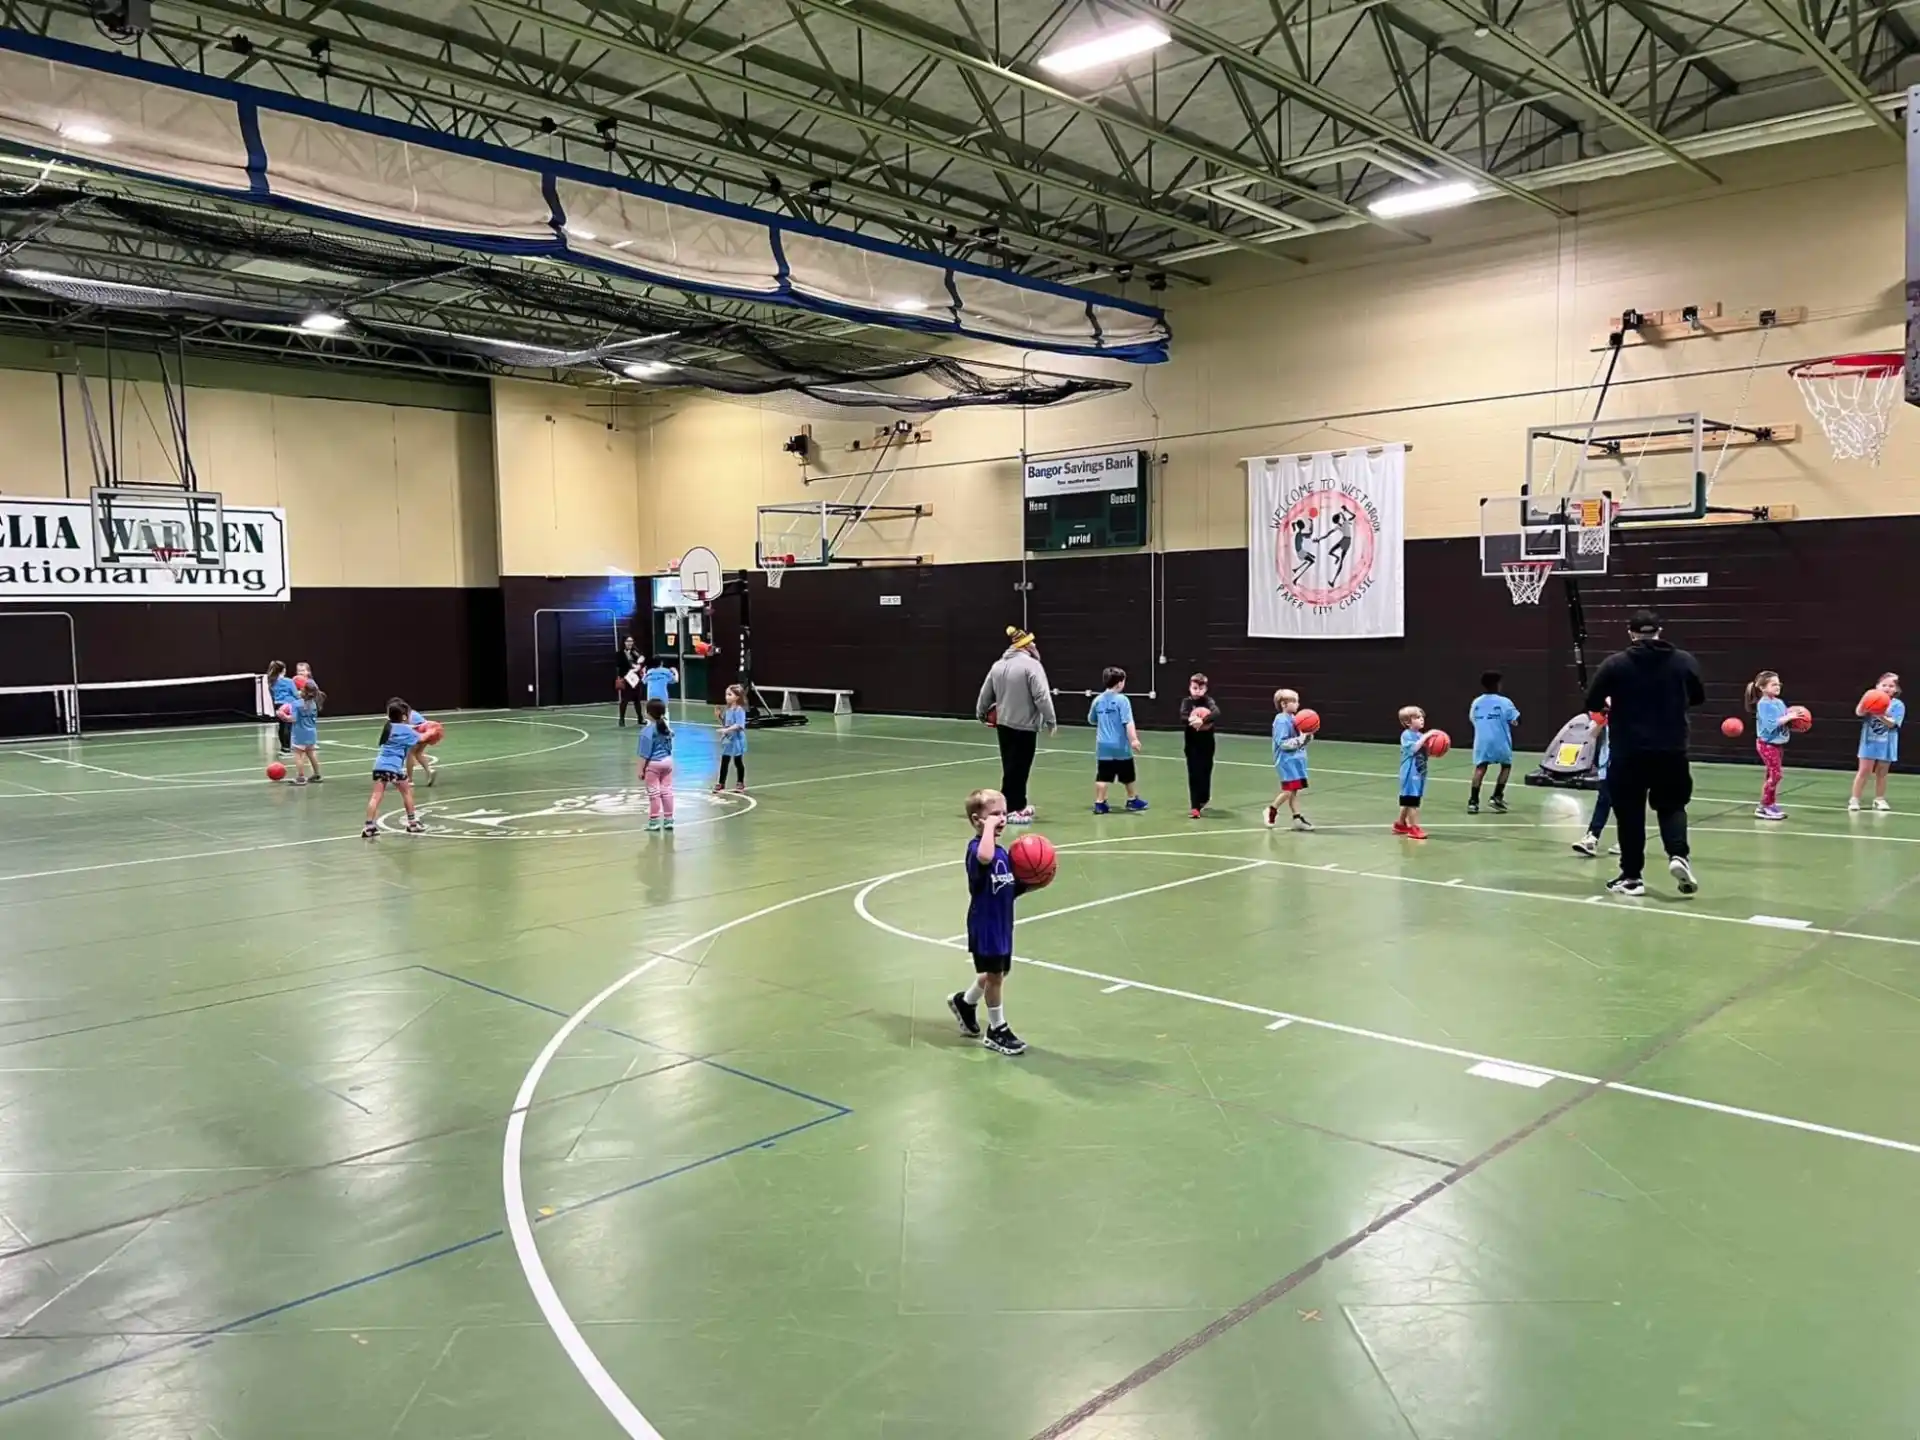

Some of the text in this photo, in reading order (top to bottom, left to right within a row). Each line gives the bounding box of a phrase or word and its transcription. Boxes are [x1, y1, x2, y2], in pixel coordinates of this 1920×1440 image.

[1028, 456, 1134, 480] Bangor Savings Bank
[1029, 501, 1048, 511] Home
[1110, 493, 1136, 505] Guests
[1269, 478, 1380, 533] WELCOME TO WESTBROOK
[99, 518, 265, 553] WARREN
[1068, 533, 1091, 546] period
[1663, 575, 1701, 586] HOME
[1275, 576, 1375, 616] PAPER CITY CLASSIC
